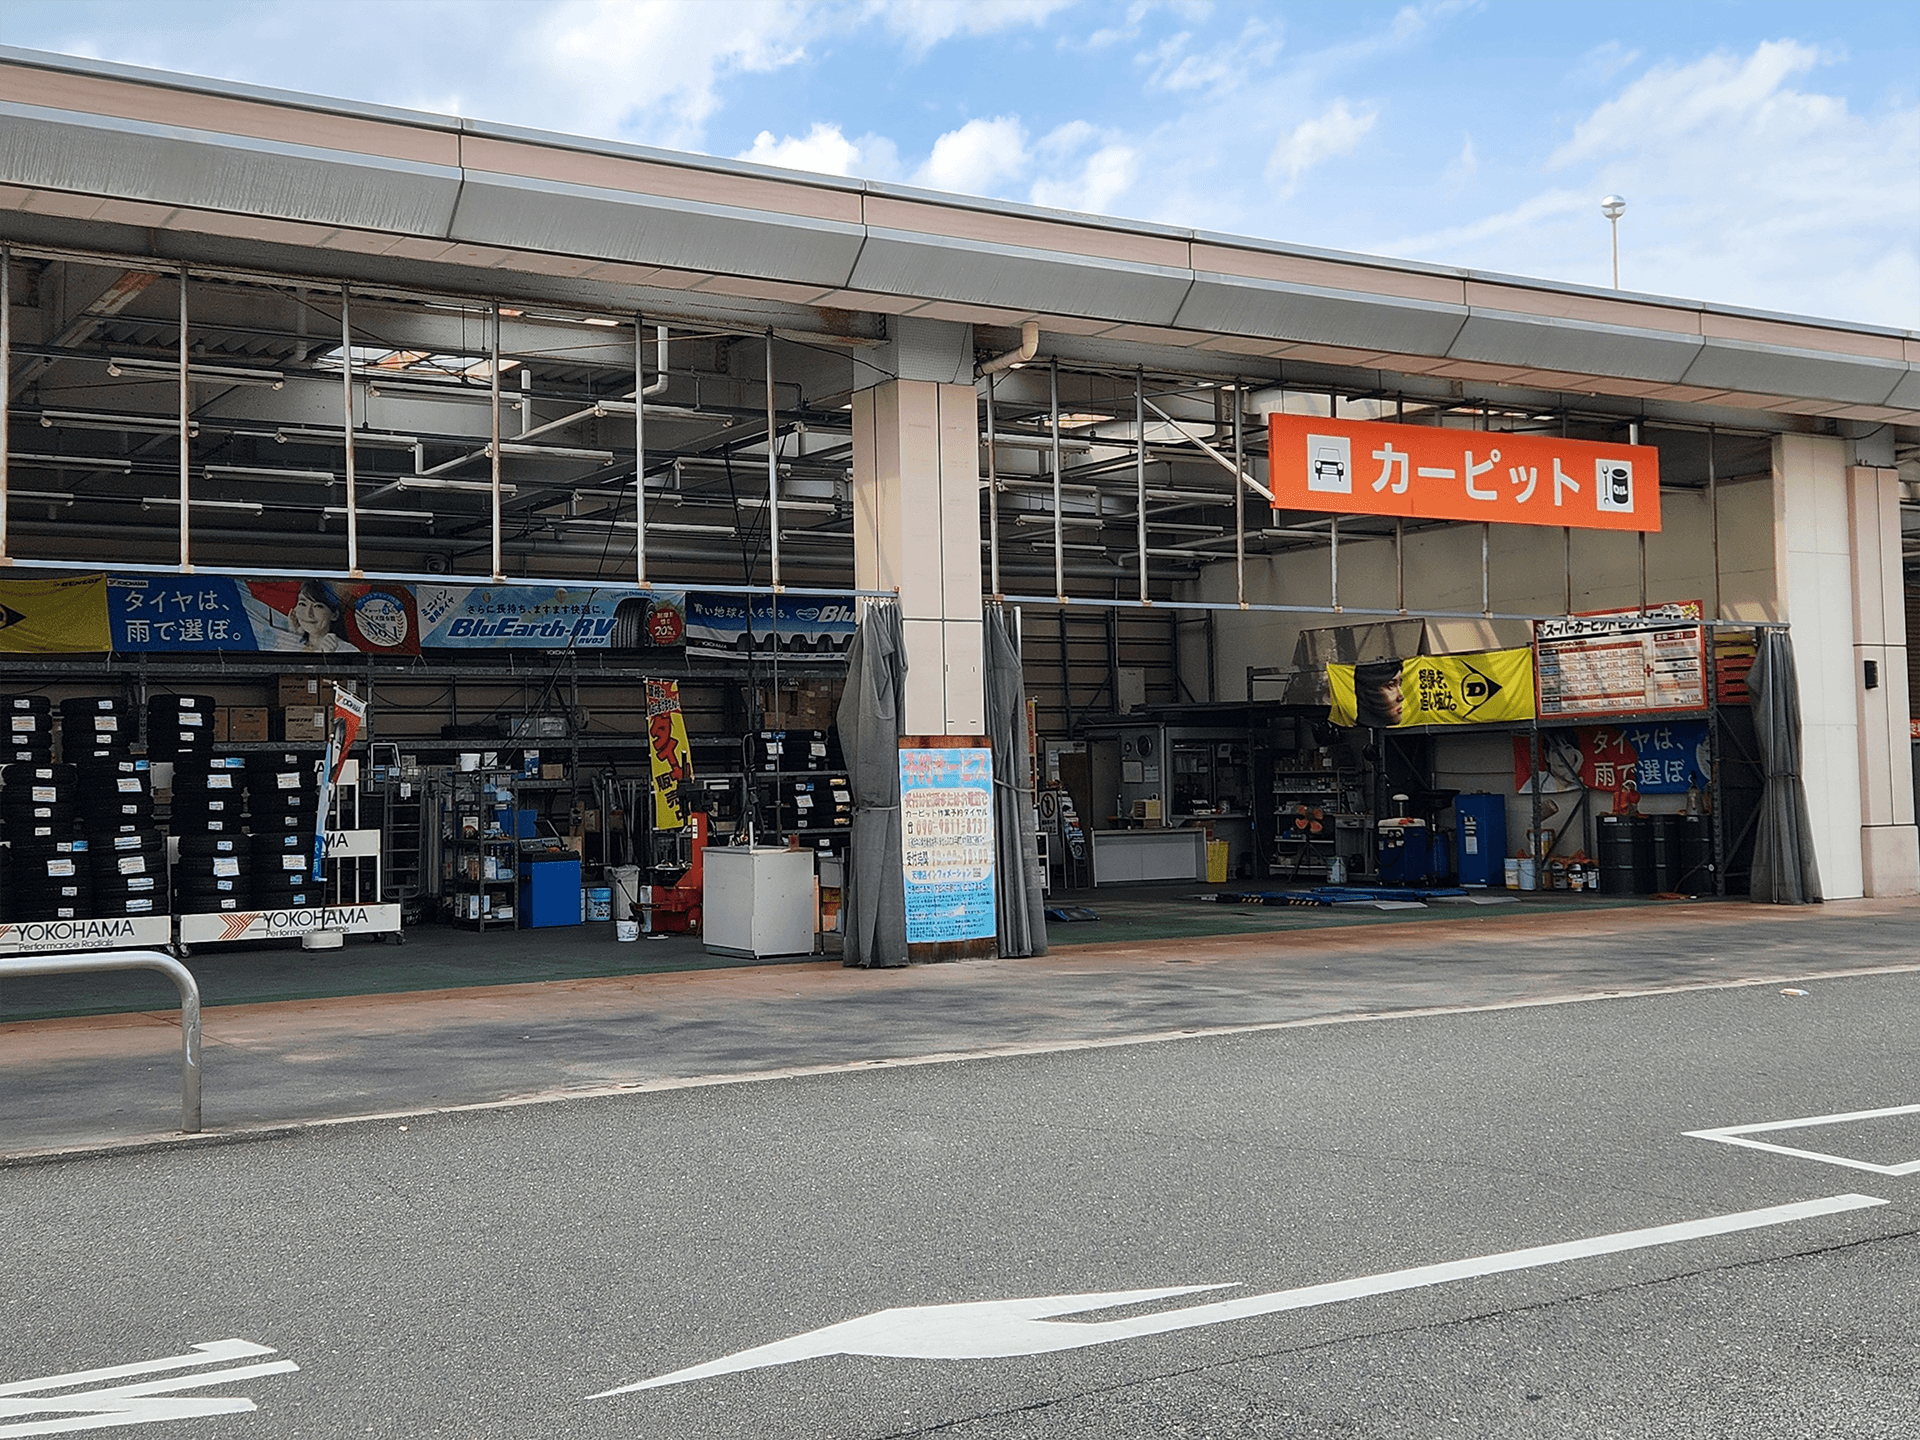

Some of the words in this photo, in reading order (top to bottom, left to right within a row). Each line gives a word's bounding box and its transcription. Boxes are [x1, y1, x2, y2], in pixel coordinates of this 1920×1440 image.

[1371, 442, 1581, 507] カーピット
[1613, 484, 1628, 496] OIL
[125, 590, 230, 613] タイヤは、
[125, 618, 242, 643] 雨で選ぼ。
[447, 617, 618, 637] BluEarth-RV
[1593, 727, 1684, 754] タイヤは、
[263, 907, 369, 929] YOKOHAMA
[16, 919, 135, 942] YOKOHAMA
[18, 940, 80, 952] Performance
[81, 938, 114, 949] Radials
